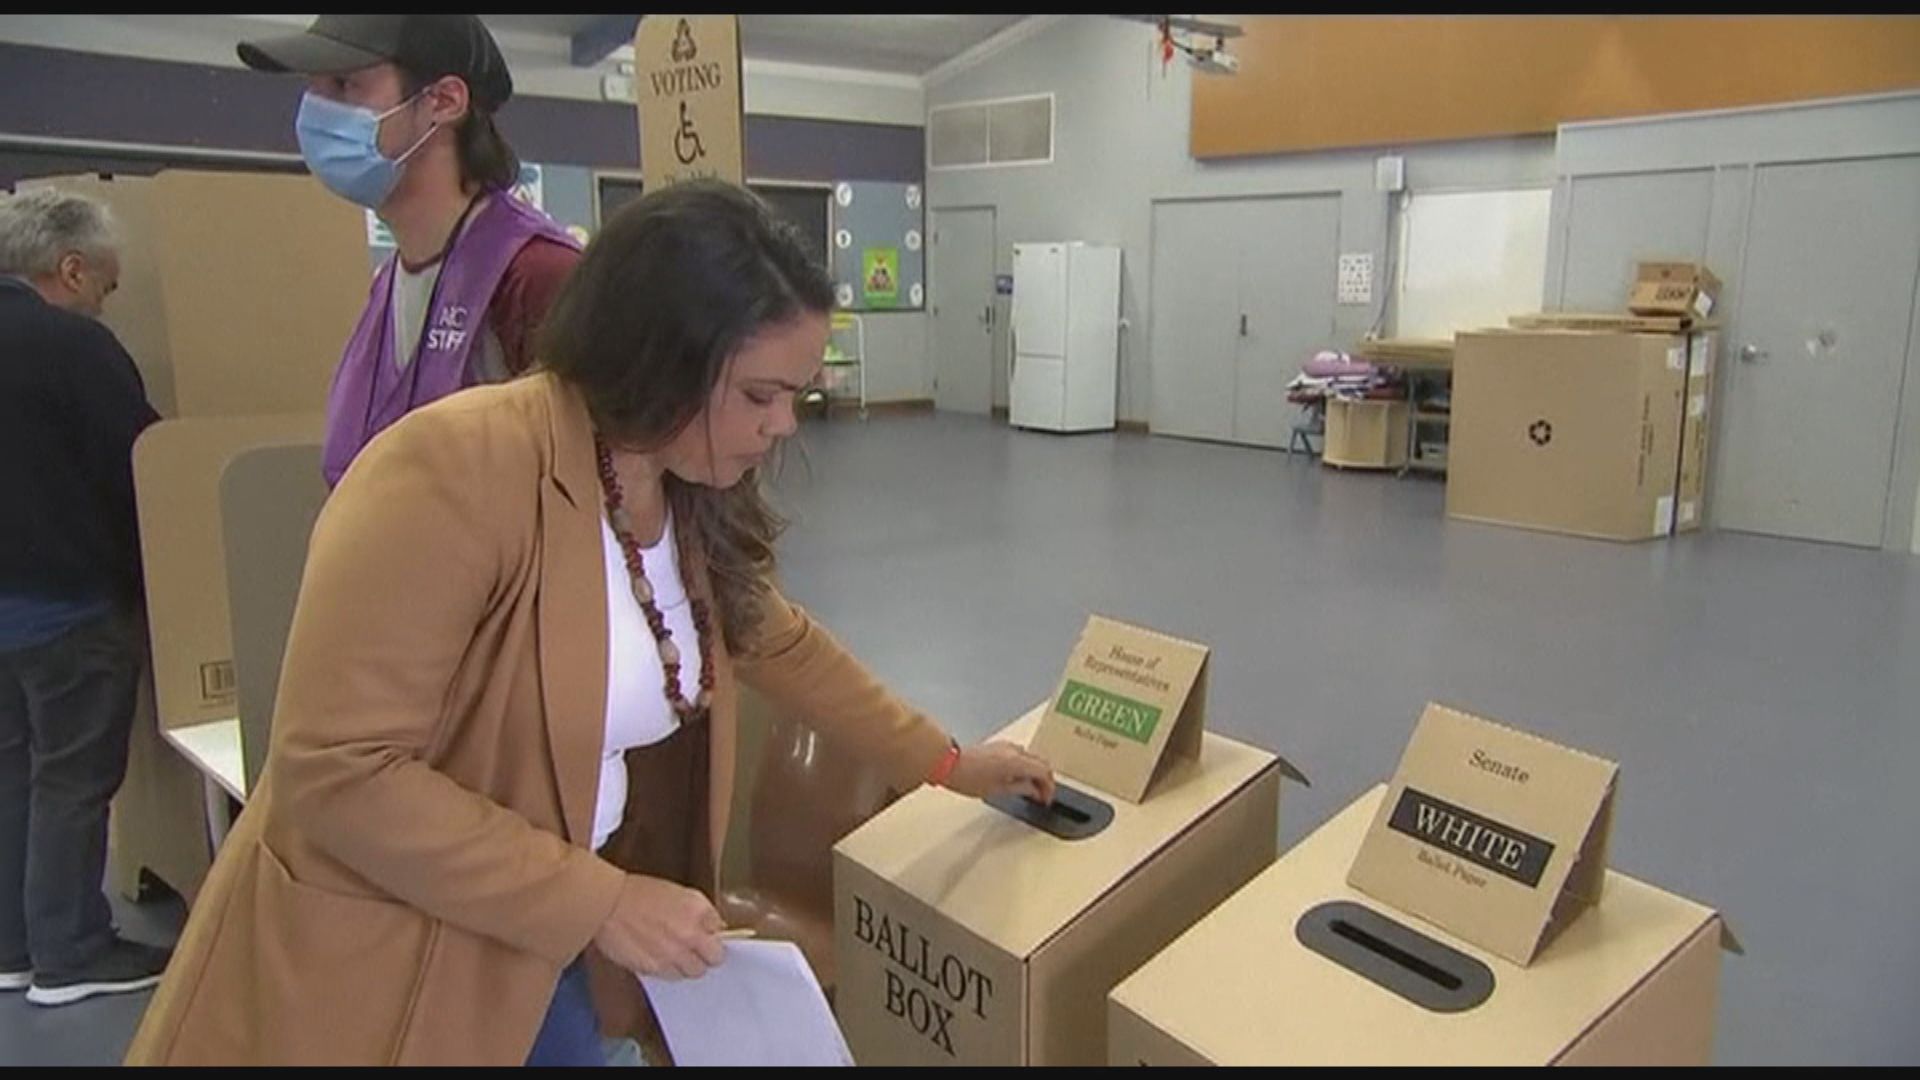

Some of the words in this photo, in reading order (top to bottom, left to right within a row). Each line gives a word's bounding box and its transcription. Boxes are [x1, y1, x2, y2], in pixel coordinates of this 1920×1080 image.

[651, 62, 721, 97] VOTING
[1083, 653, 1171, 692] Representatives
[1109, 644, 1146, 667] House
[1146, 655, 1163, 670] of
[1067, 688, 1149, 735] GREEN
[1470, 750, 1529, 783] Senate
[1415, 804, 1526, 870] WHITE
[1418, 850, 1452, 873] Ballot
[1453, 864, 1487, 889] Paper
[853, 894, 993, 1021] BALLOT
[884, 967, 957, 1058] BOX
